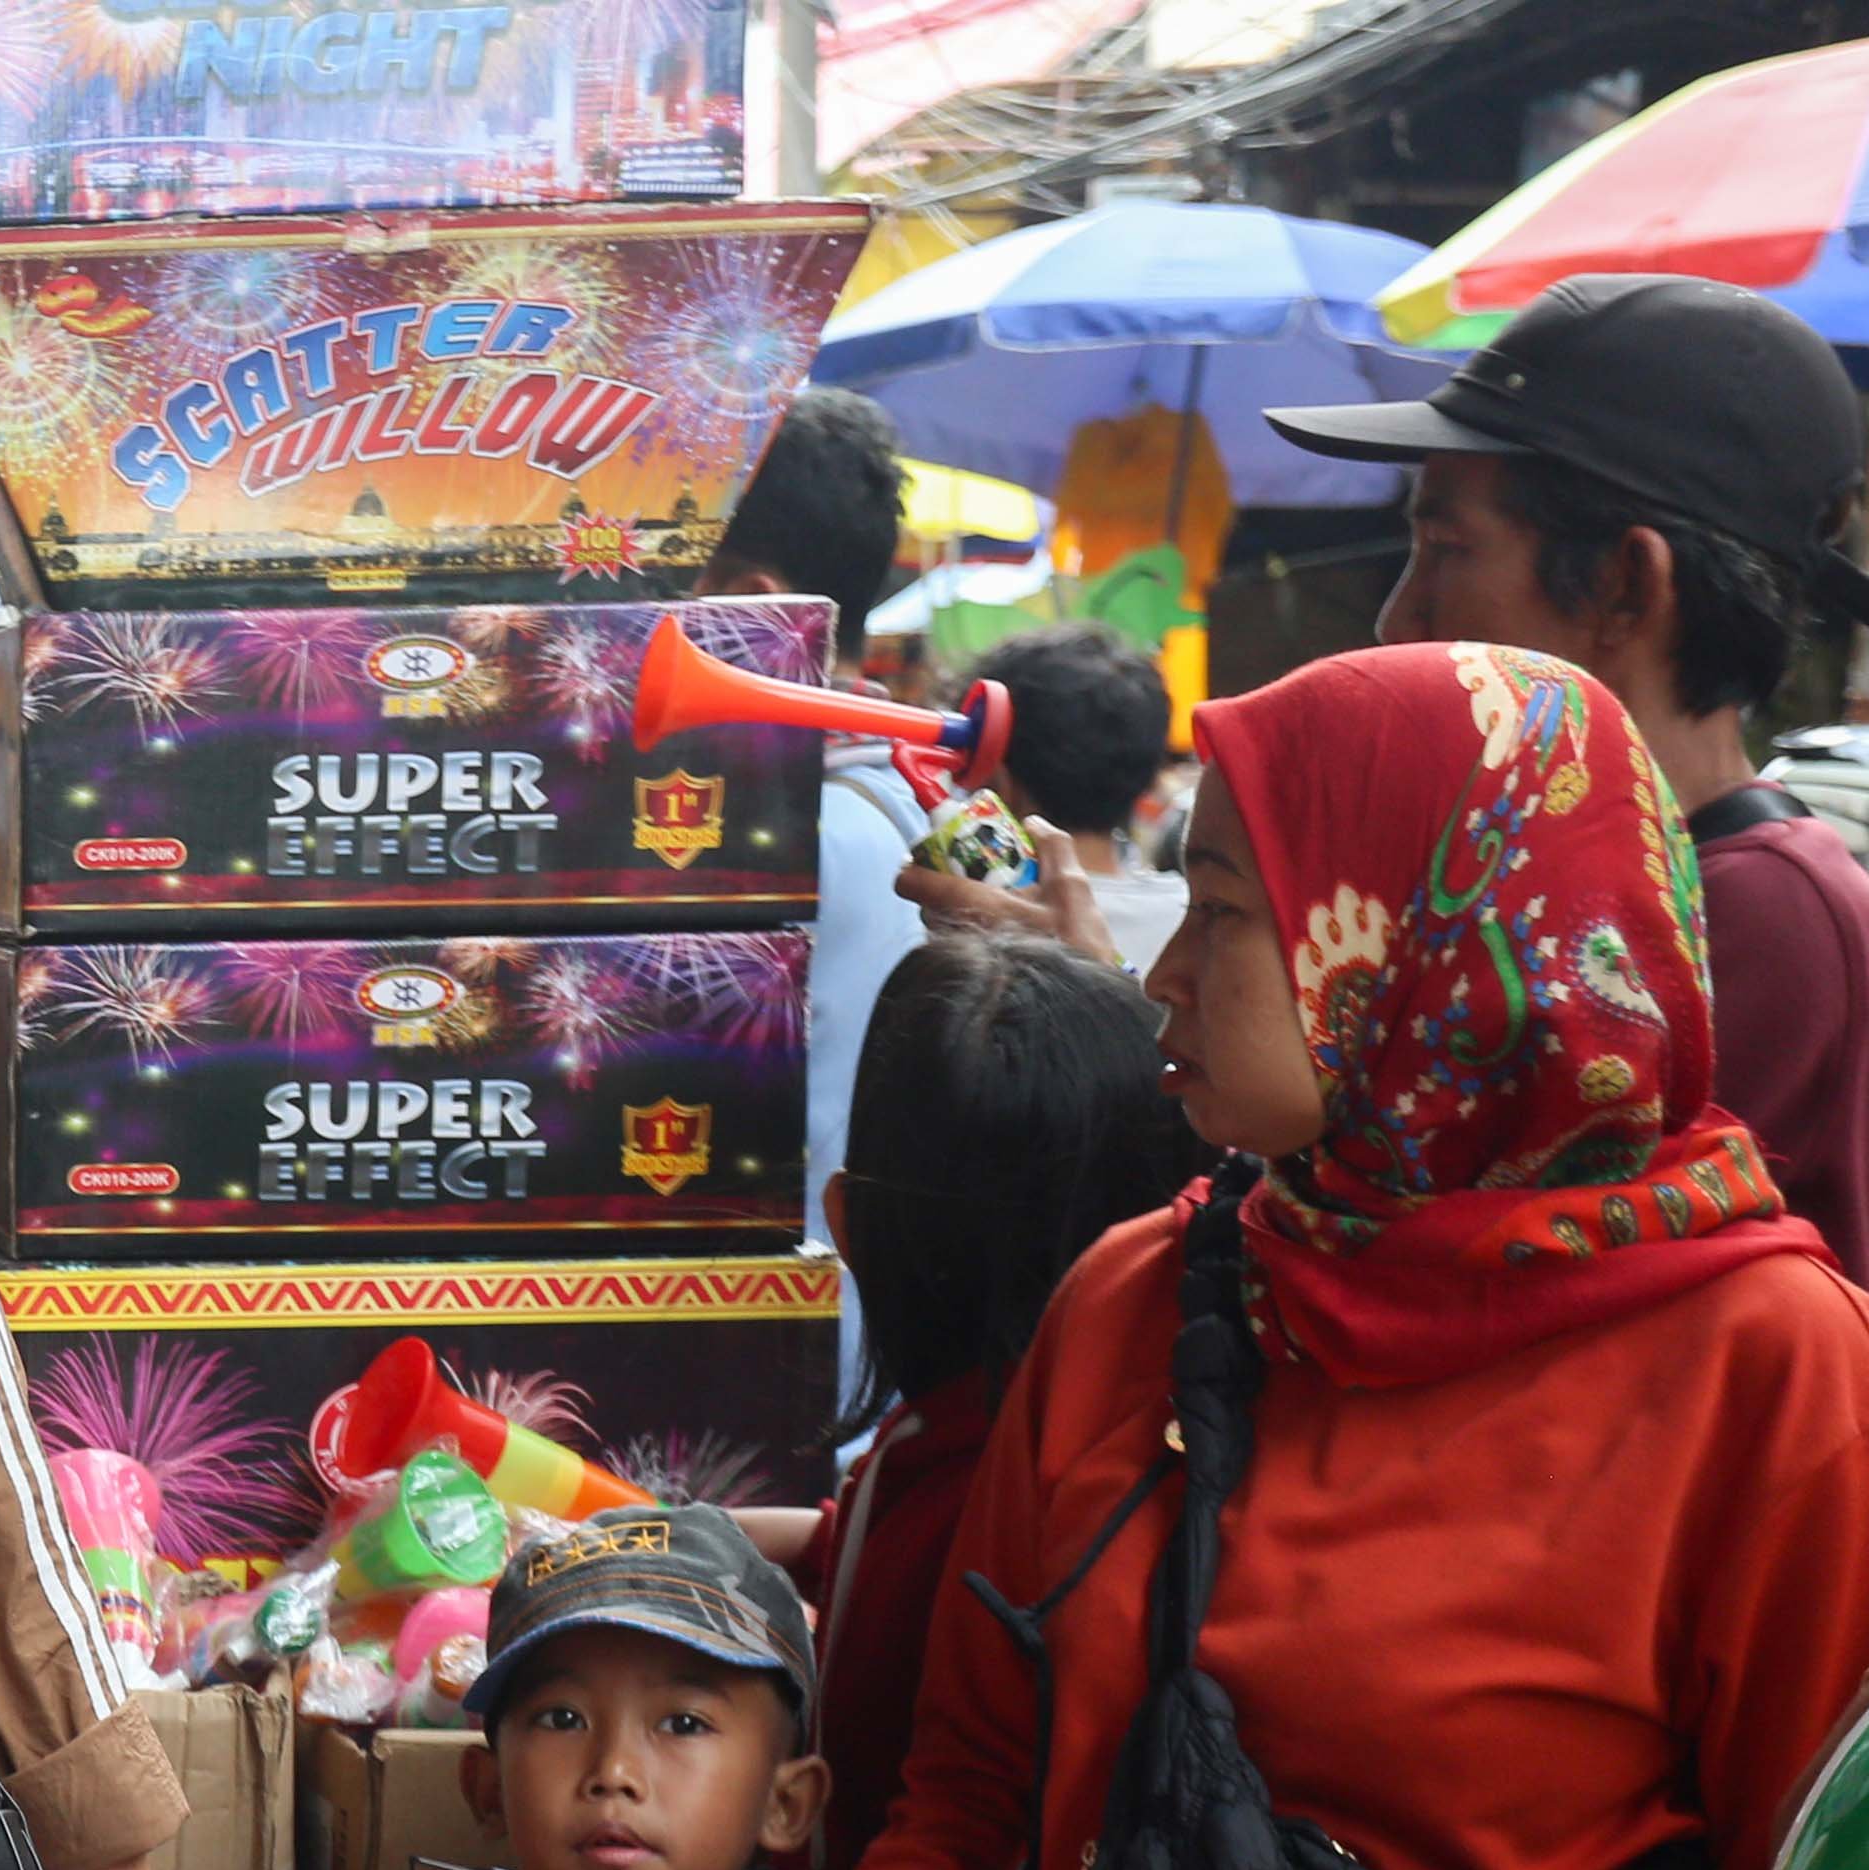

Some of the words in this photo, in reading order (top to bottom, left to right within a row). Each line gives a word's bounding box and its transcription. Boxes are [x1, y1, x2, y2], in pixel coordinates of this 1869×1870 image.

[175, 8, 510, 99] NIGHT
[111, 300, 578, 512] SCATTER
[239, 372, 661, 497] WILLOW
[581, 527, 622, 550] 100
[271, 752, 548, 816] SUPER
[266, 815, 558, 876] EFFECT
[264, 1080, 538, 1142] SUPER
[259, 1141, 547, 1202] EFFECT
